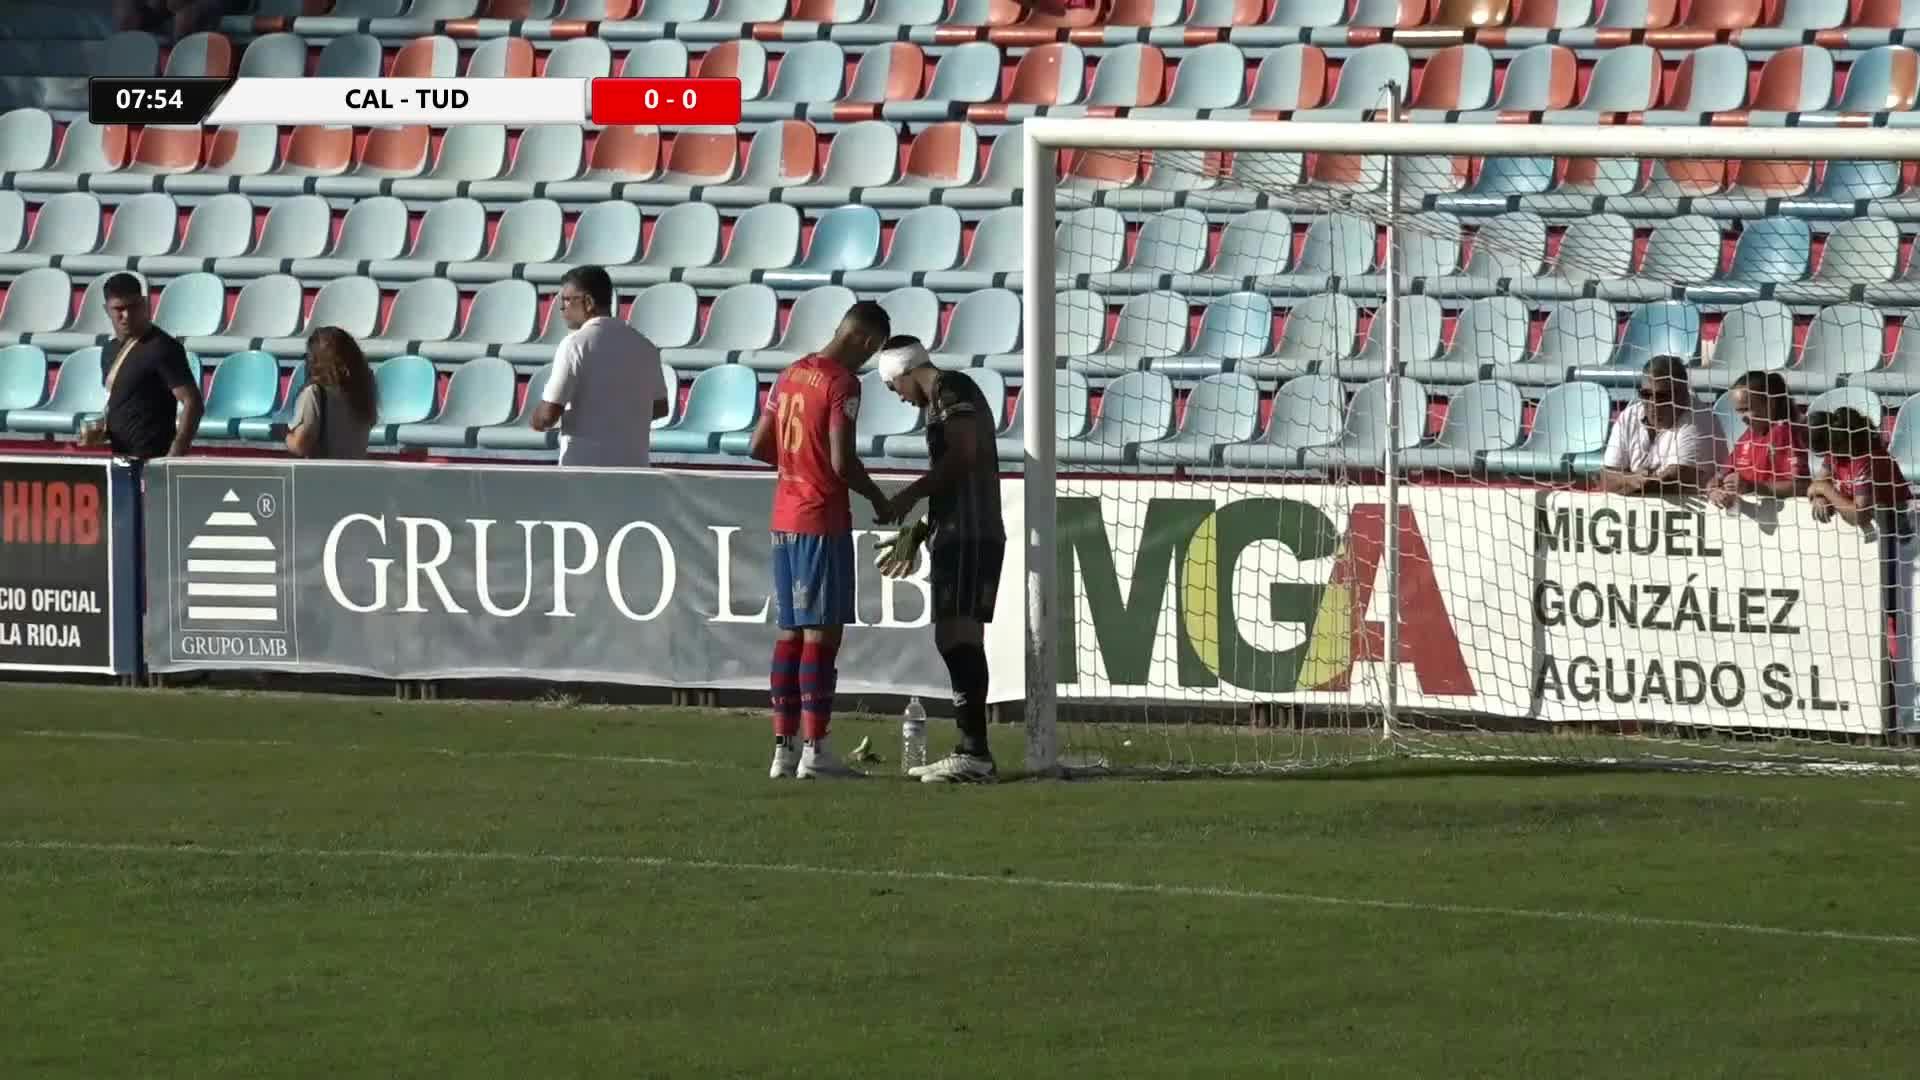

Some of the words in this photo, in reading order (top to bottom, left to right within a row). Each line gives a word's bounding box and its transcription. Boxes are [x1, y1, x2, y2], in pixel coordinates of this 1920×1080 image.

[777, 391, 805, 454] 16
[3, 481, 98, 544] HIAB
[1534, 507, 1723, 557] MIGUEL
[322, 512, 677, 621] GRUPO
[707, 525, 932, 628] LB
[1056, 497, 1478, 696] MGA
[31, 588, 101, 613] OFICIAL
[1534, 573, 1801, 634] GONZÁLEZ
[0, 623, 22, 646] LA
[27, 624, 81, 648] RIOJA
[182, 636, 244, 656] GRUPO
[248, 637, 288, 657] LMB
[1535, 654, 1746, 708] AGUADO
[1762, 662, 1849, 712] S.L.
